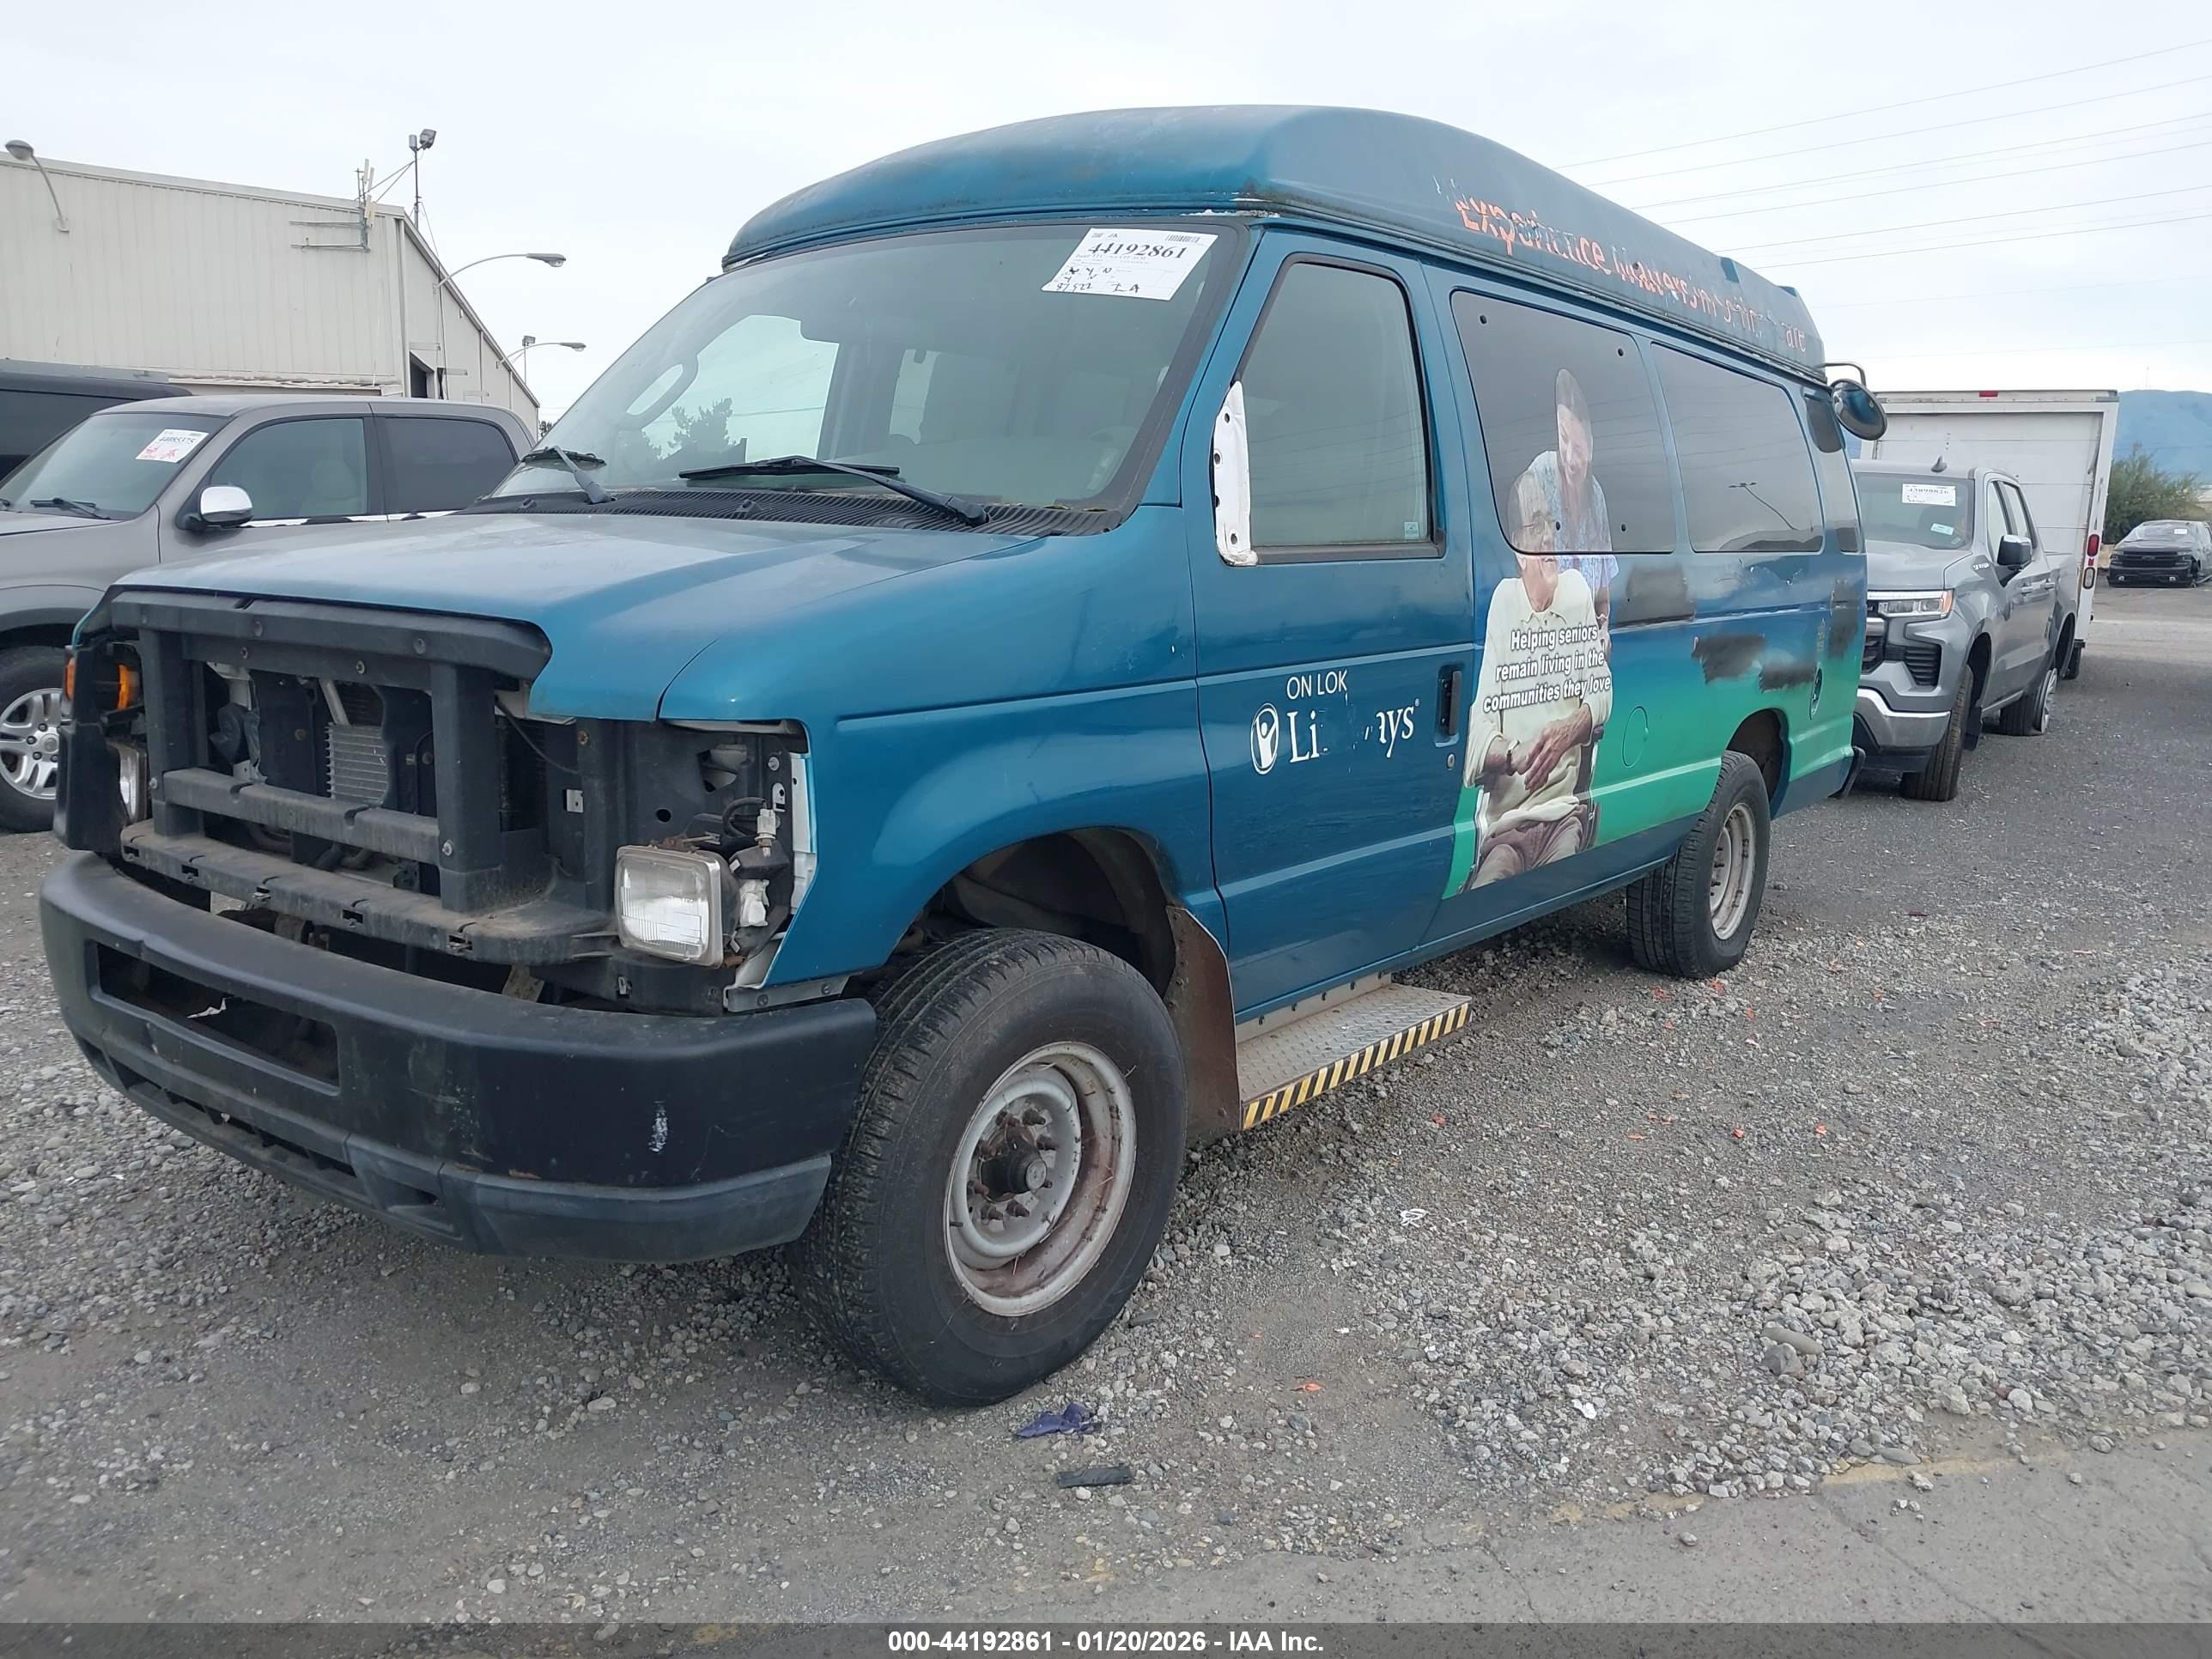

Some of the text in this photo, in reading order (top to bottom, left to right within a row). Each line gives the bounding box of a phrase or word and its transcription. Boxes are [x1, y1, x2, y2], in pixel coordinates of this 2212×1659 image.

[1088, 242, 1188, 258] 44192861
[1511, 623, 1598, 652] Helping seniors
[1496, 648, 1604, 682] remain living in the
[1286, 669, 1347, 700] ON LOK
[1483, 674, 1611, 713] communities they love
